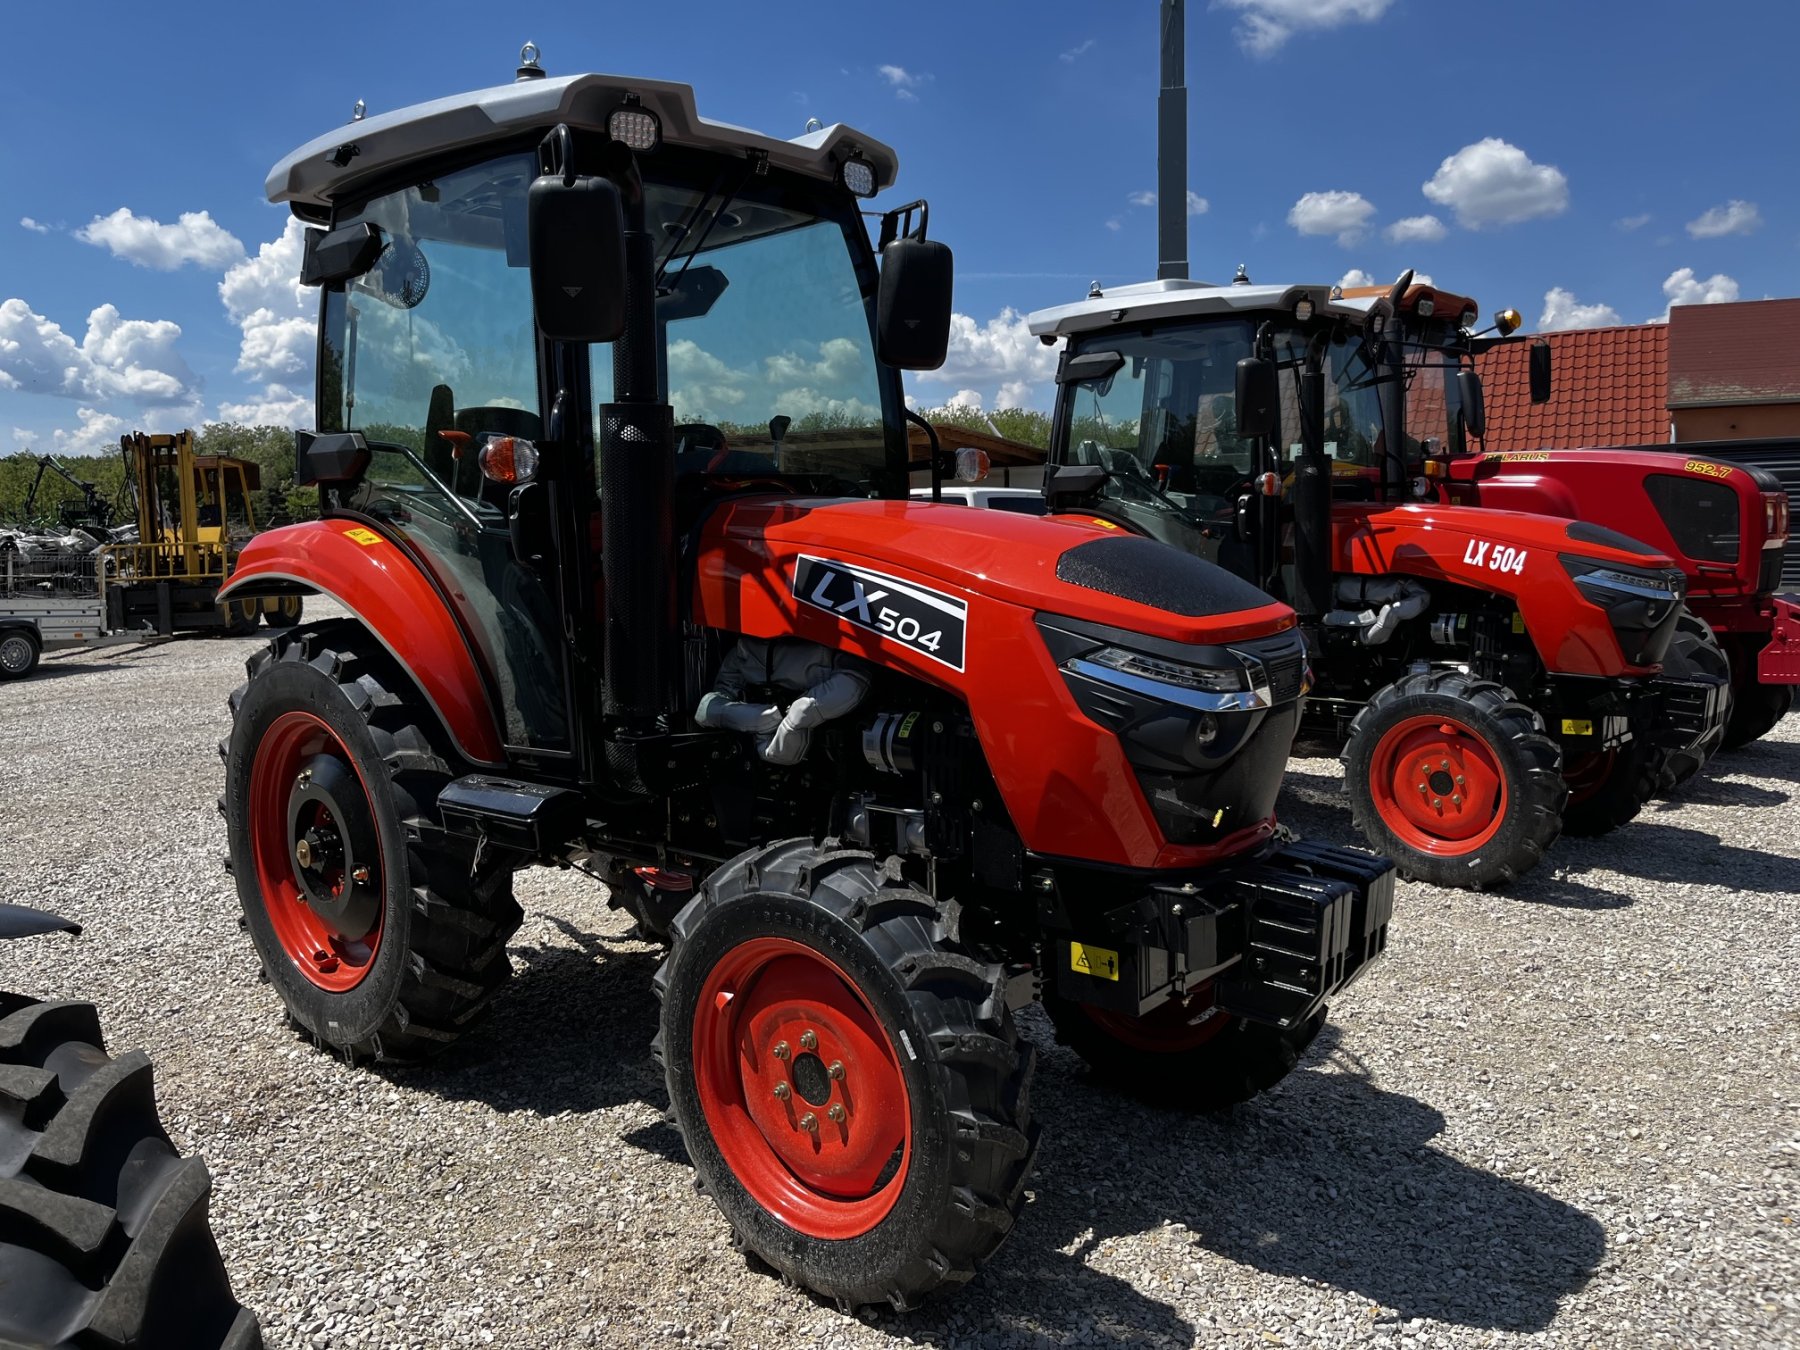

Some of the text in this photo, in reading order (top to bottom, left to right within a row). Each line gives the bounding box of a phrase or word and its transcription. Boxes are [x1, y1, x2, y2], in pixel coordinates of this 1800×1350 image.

[1684, 460, 1733, 478] 952.7
[1463, 539, 1528, 576] LX 504
